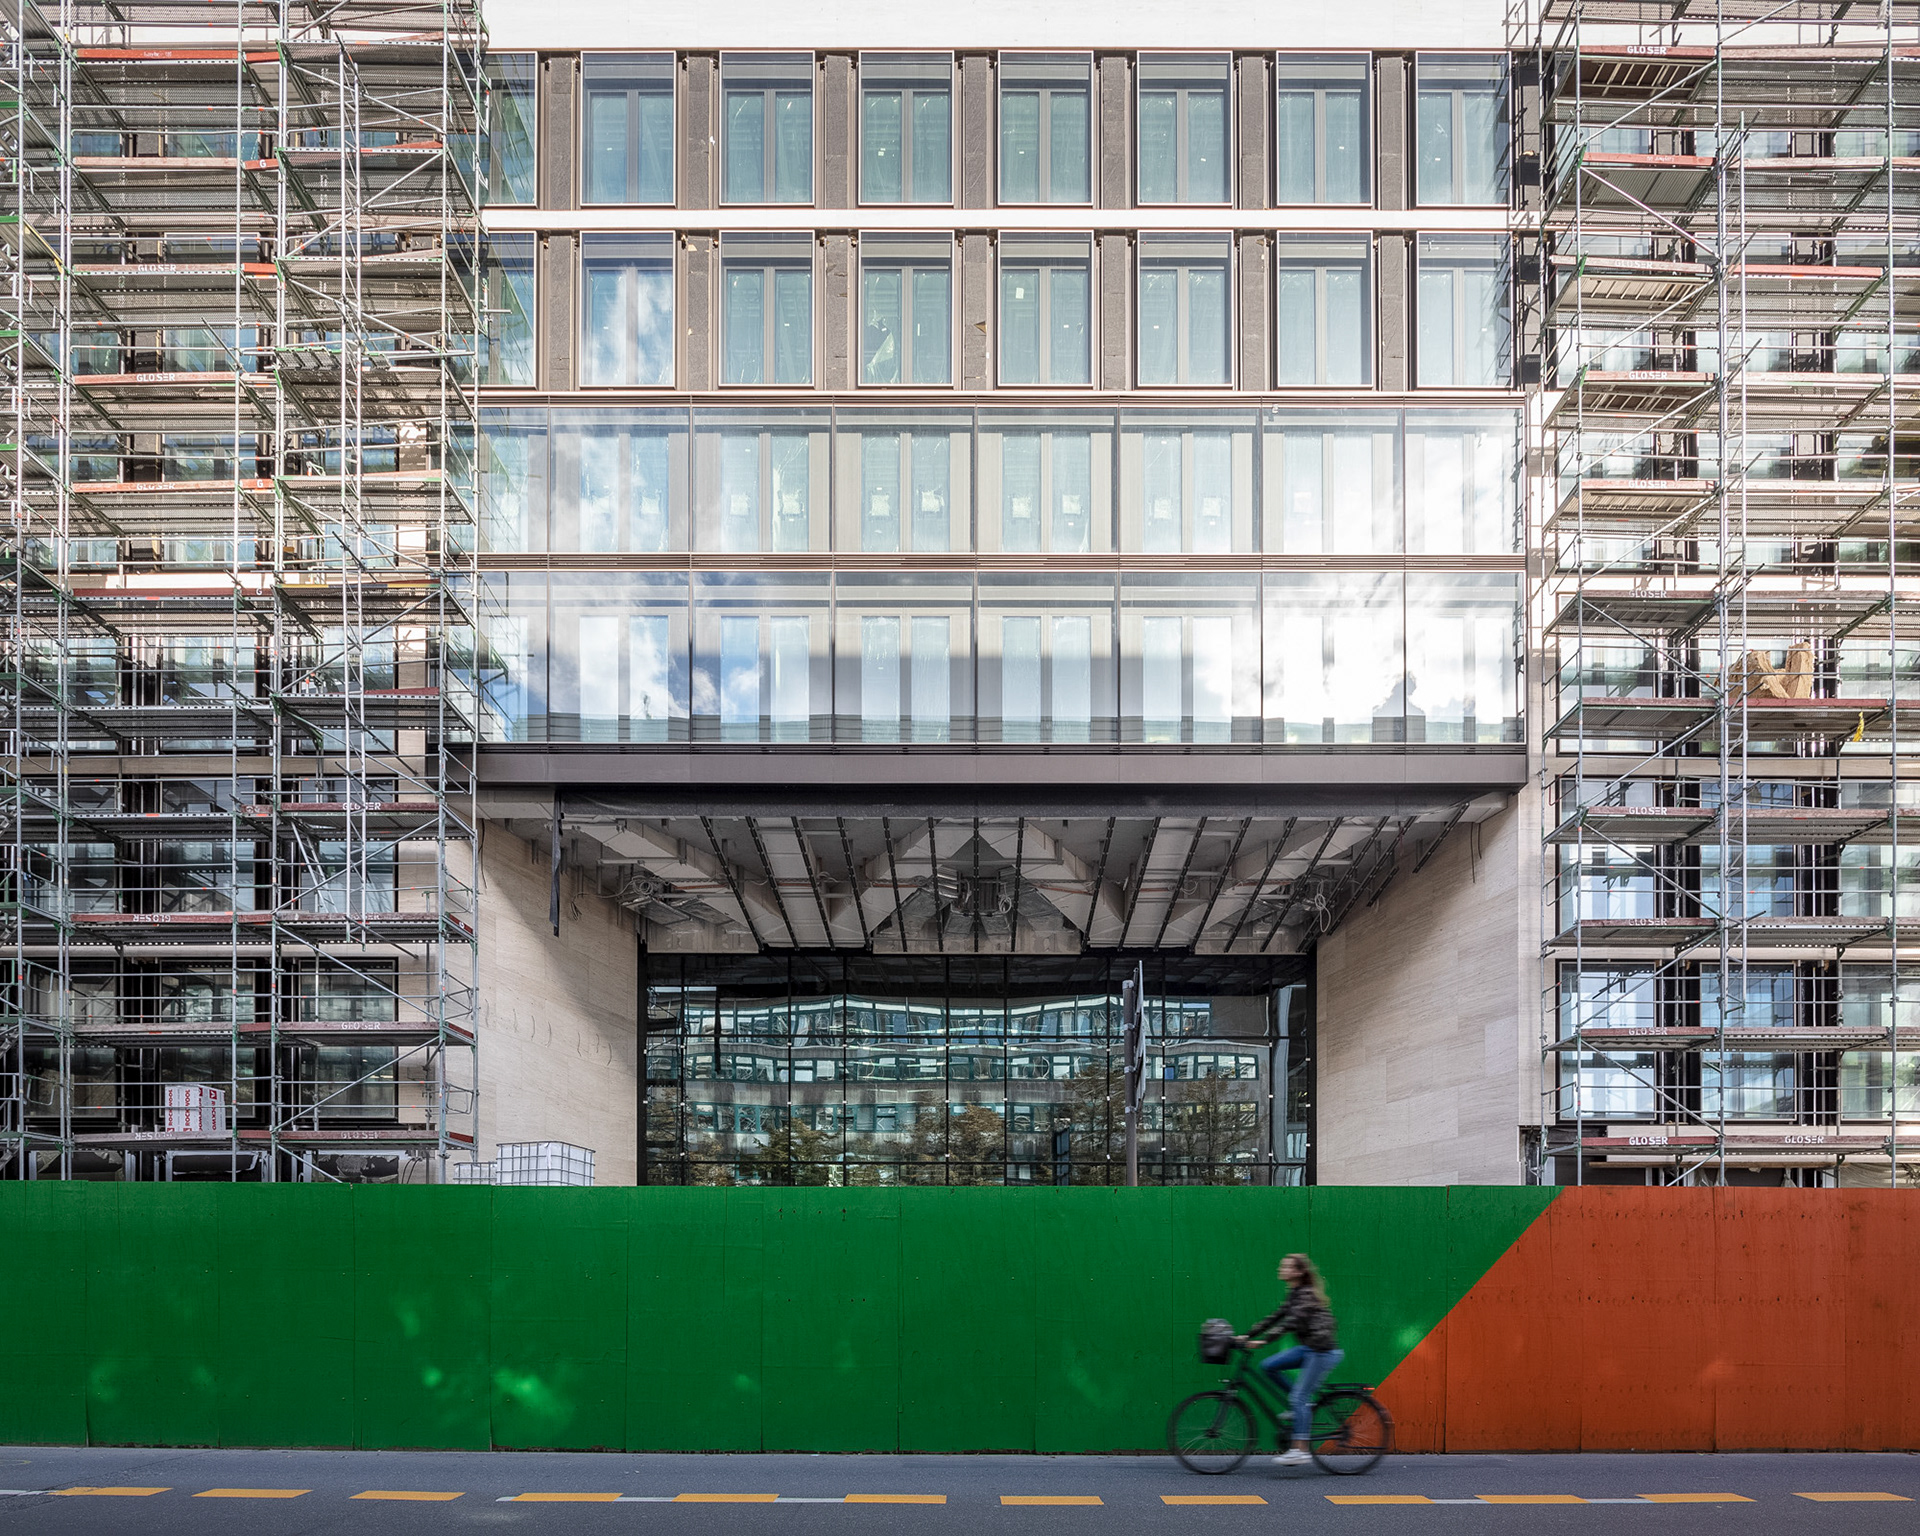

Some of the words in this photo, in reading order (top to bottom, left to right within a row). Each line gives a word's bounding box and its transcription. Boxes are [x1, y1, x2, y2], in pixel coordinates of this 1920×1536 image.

[1627, 46, 1667, 54] GLOSER
[259, 159, 267, 168] G
[138, 264, 177, 272] GLOSER
[1614, 260, 1653, 269] GLOSER
[136, 373, 175, 382] GLOSER
[1629, 371, 1667, 380] GLOSER
[257, 480, 264, 488] G
[1628, 480, 1667, 489] GLOSER
[1629, 590, 1667, 598] GLOSER
[1628, 807, 1667, 815] GLOSER
[1629, 918, 1667, 926] GLOSER
[1628, 1027, 1667, 1035] GLOSER
[1629, 1137, 1668, 1145] GLOSER
[1785, 1136, 1825, 1144] GLOSER
